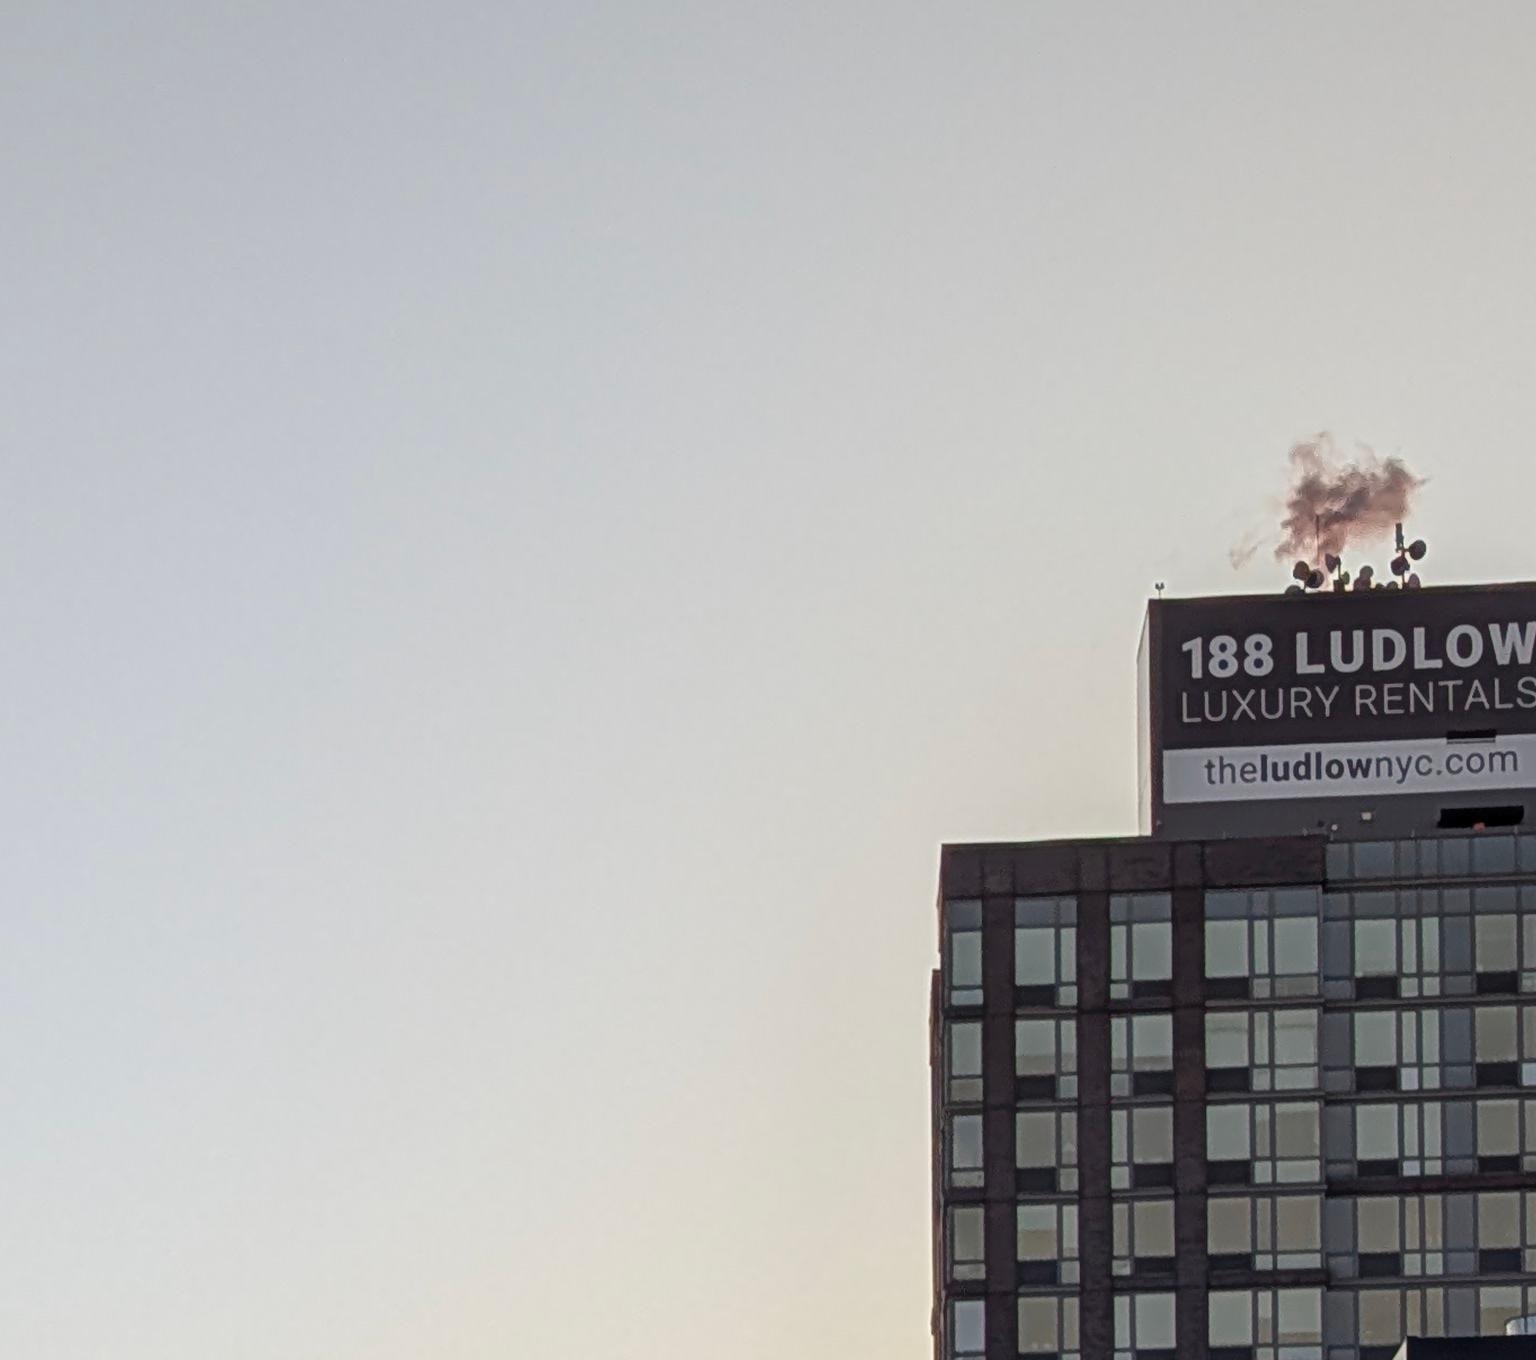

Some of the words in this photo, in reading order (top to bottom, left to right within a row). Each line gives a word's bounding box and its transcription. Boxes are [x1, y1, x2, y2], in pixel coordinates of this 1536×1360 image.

[1181, 634, 1273, 679] 188
[1296, 622, 1536, 674] LUDLOW
[1181, 686, 1340, 724] LUXURY
[1355, 677, 1536, 716] RENTALS
[1205, 750, 1518, 785] theludlownyc.com
